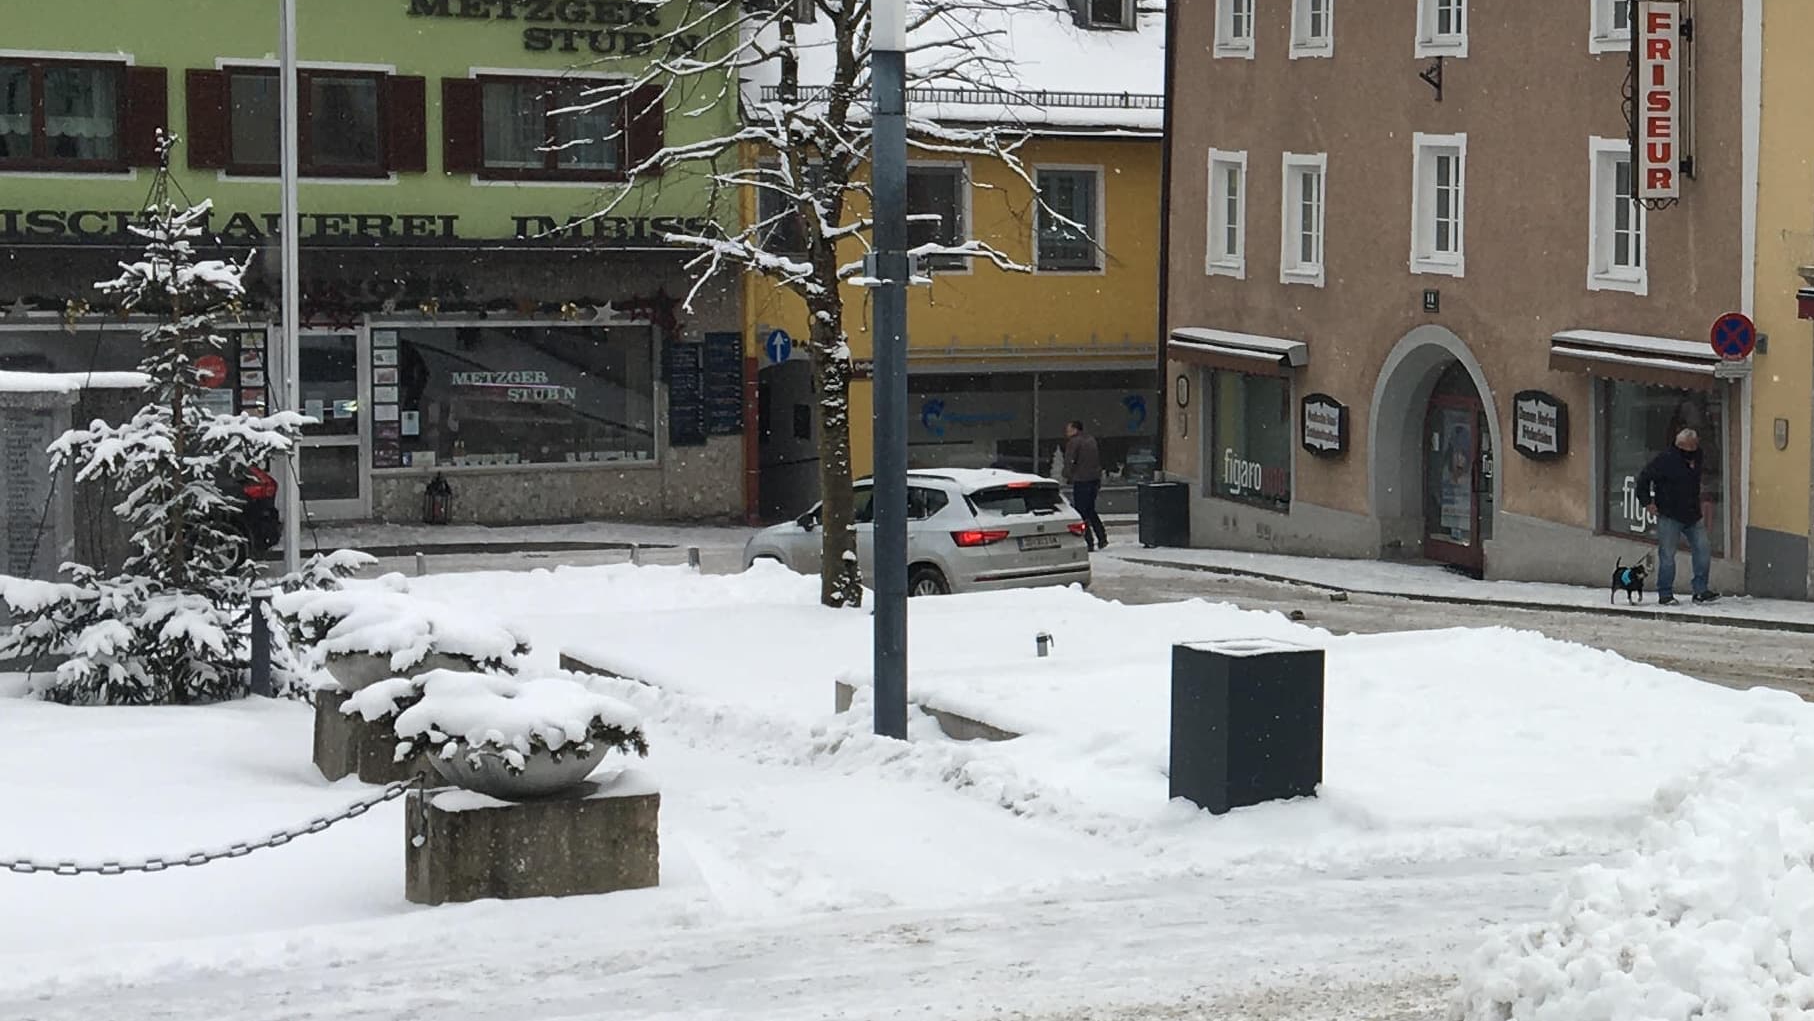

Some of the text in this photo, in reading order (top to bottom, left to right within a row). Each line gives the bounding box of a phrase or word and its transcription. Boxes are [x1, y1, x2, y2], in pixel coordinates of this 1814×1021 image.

[1646, 12, 1672, 189] FRISEUR
[511, 215, 719, 239] IMBISS
[452, 371, 549, 385] METZGER
